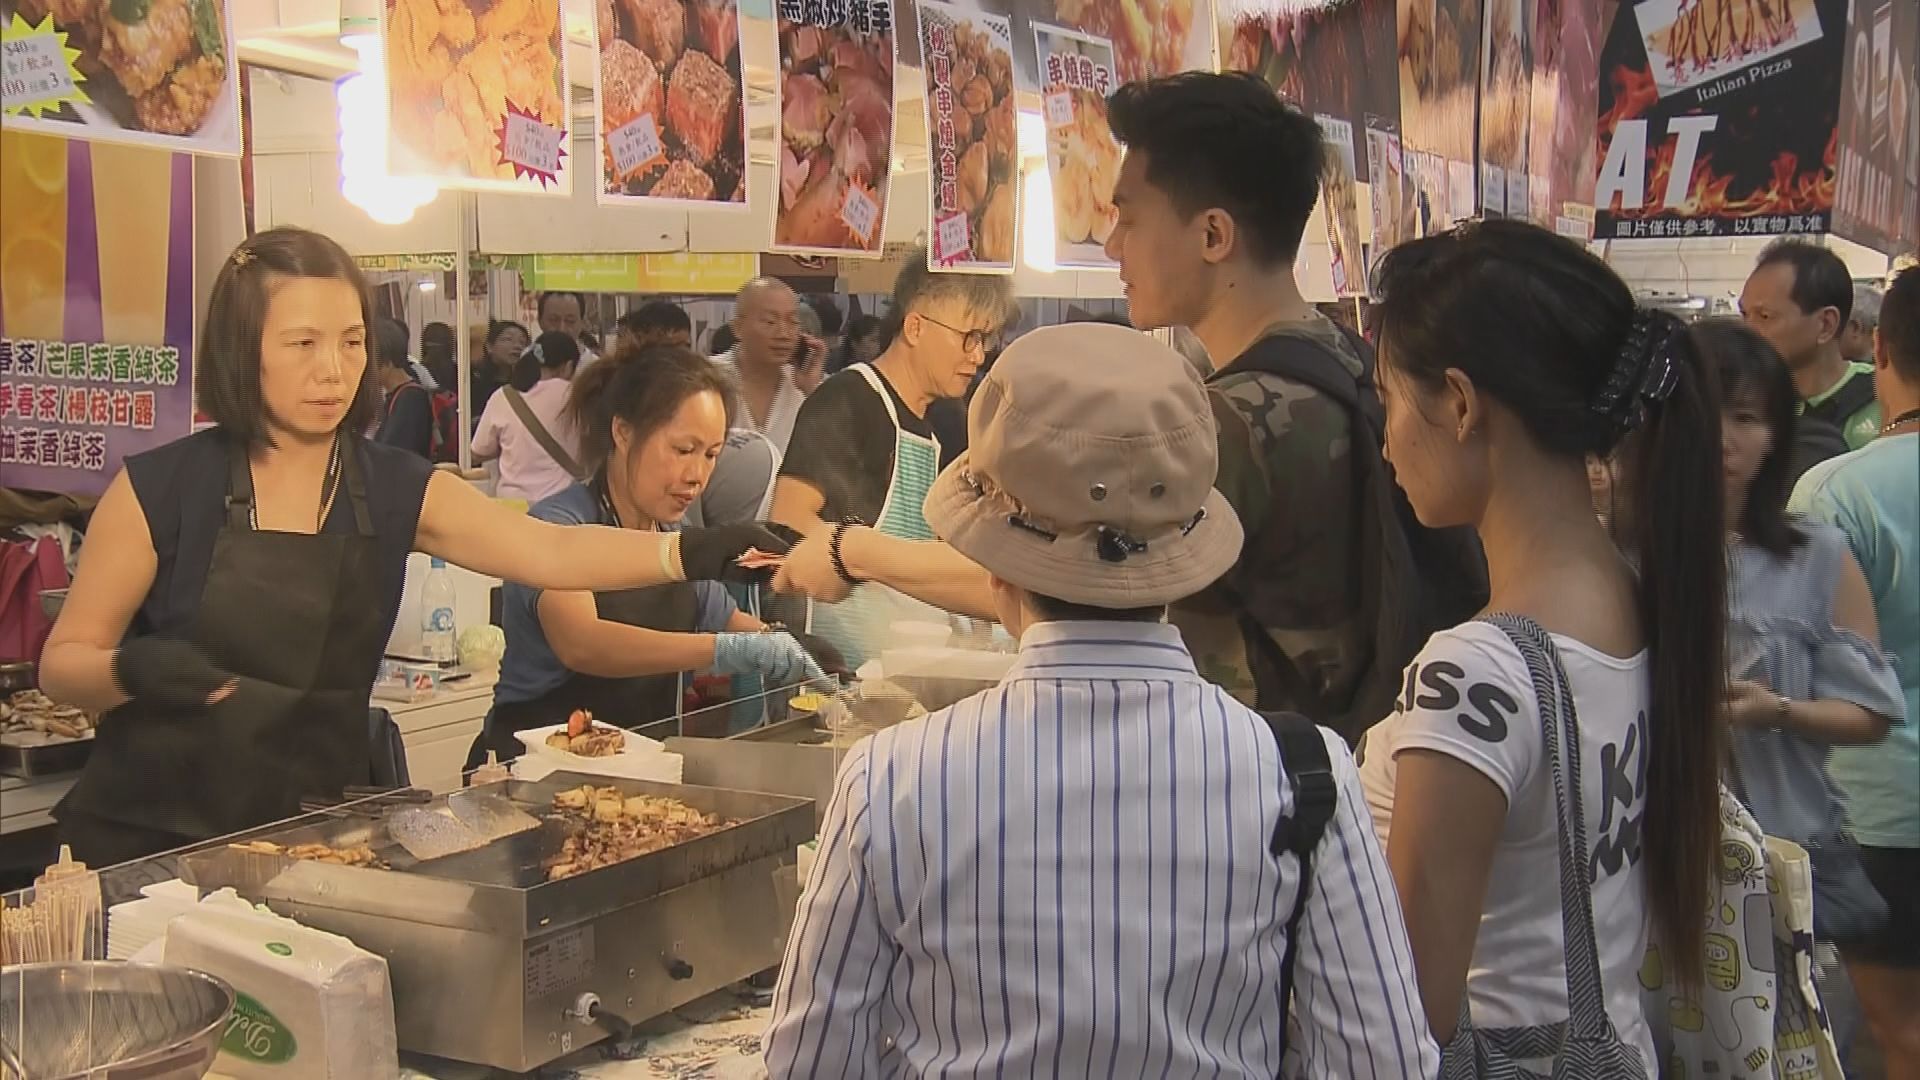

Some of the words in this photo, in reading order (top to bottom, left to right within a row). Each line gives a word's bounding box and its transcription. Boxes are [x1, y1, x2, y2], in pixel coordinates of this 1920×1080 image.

[1696, 75, 1747, 101] Italian
[1749, 56, 1794, 82] Pizza
[1394, 661, 1519, 743] ISS
